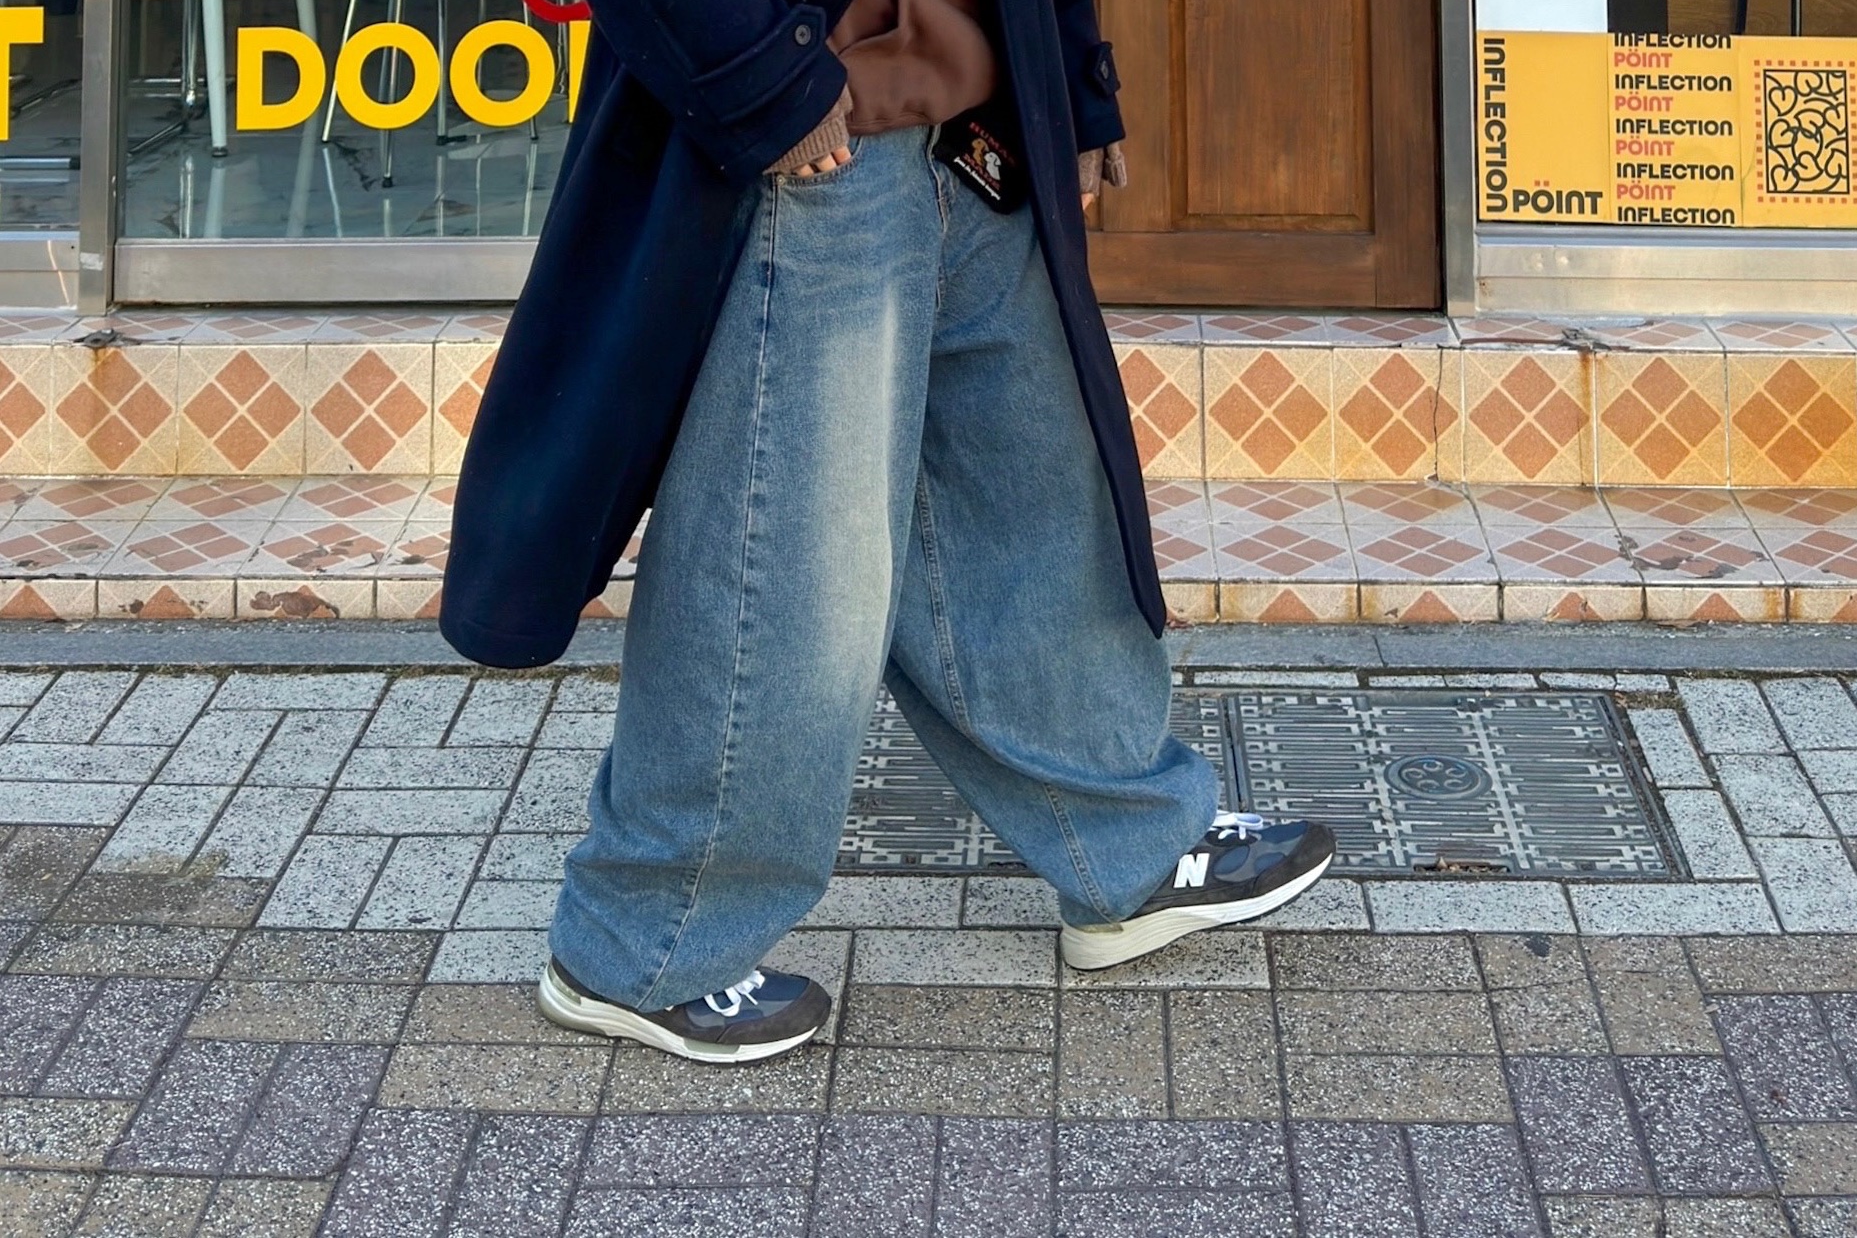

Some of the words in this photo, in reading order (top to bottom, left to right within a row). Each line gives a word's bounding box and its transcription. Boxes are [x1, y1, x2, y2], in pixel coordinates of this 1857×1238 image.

[1614, 33, 1732, 50] INFLECTION
[236, 19, 592, 131] DOO
[1615, 74, 1733, 92] INFLECTION
[1483, 37, 1508, 213] INFLECTION
[1616, 118, 1734, 137] INFLECTION
[1616, 162, 1735, 181] INFLECTION
[1617, 206, 1736, 225] INFLECTION
[1173, 852, 1210, 889] N
